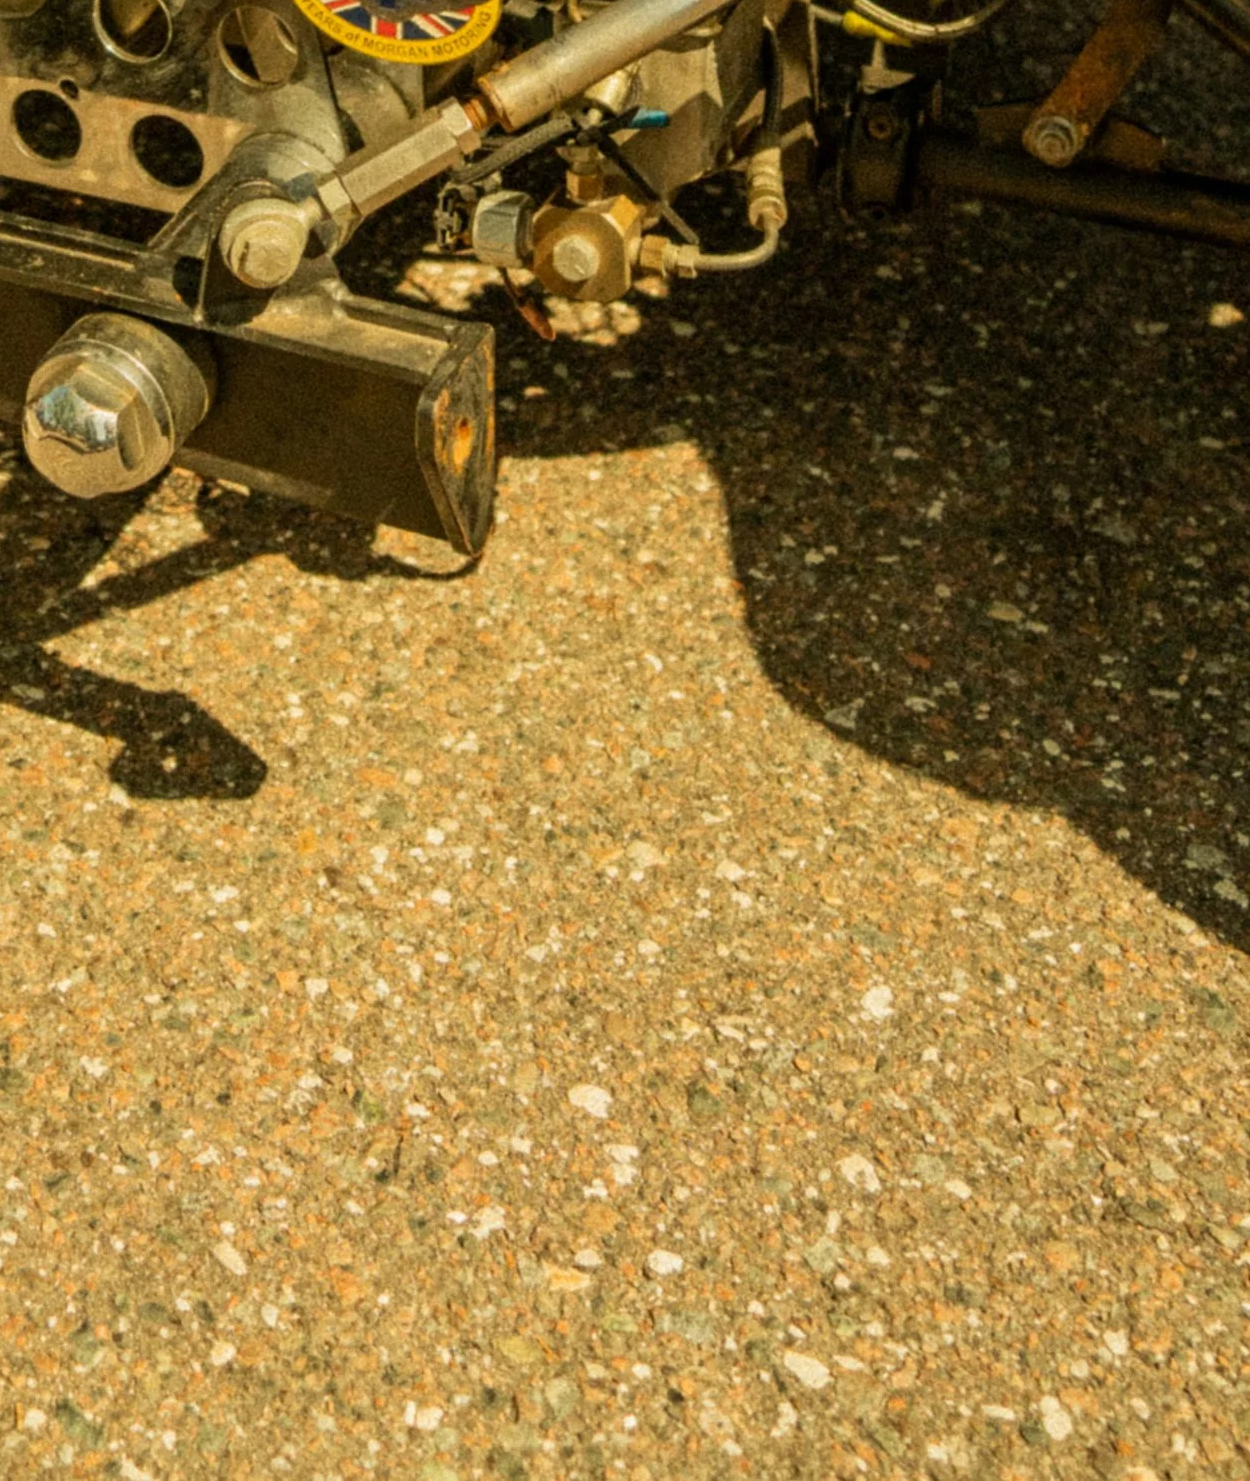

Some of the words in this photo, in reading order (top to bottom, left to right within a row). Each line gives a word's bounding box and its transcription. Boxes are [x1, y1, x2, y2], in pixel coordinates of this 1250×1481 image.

[345, 31, 360, 44] of
[362, 37, 429, 58] MORGAN
[430, 11, 492, 57] MOTORING
